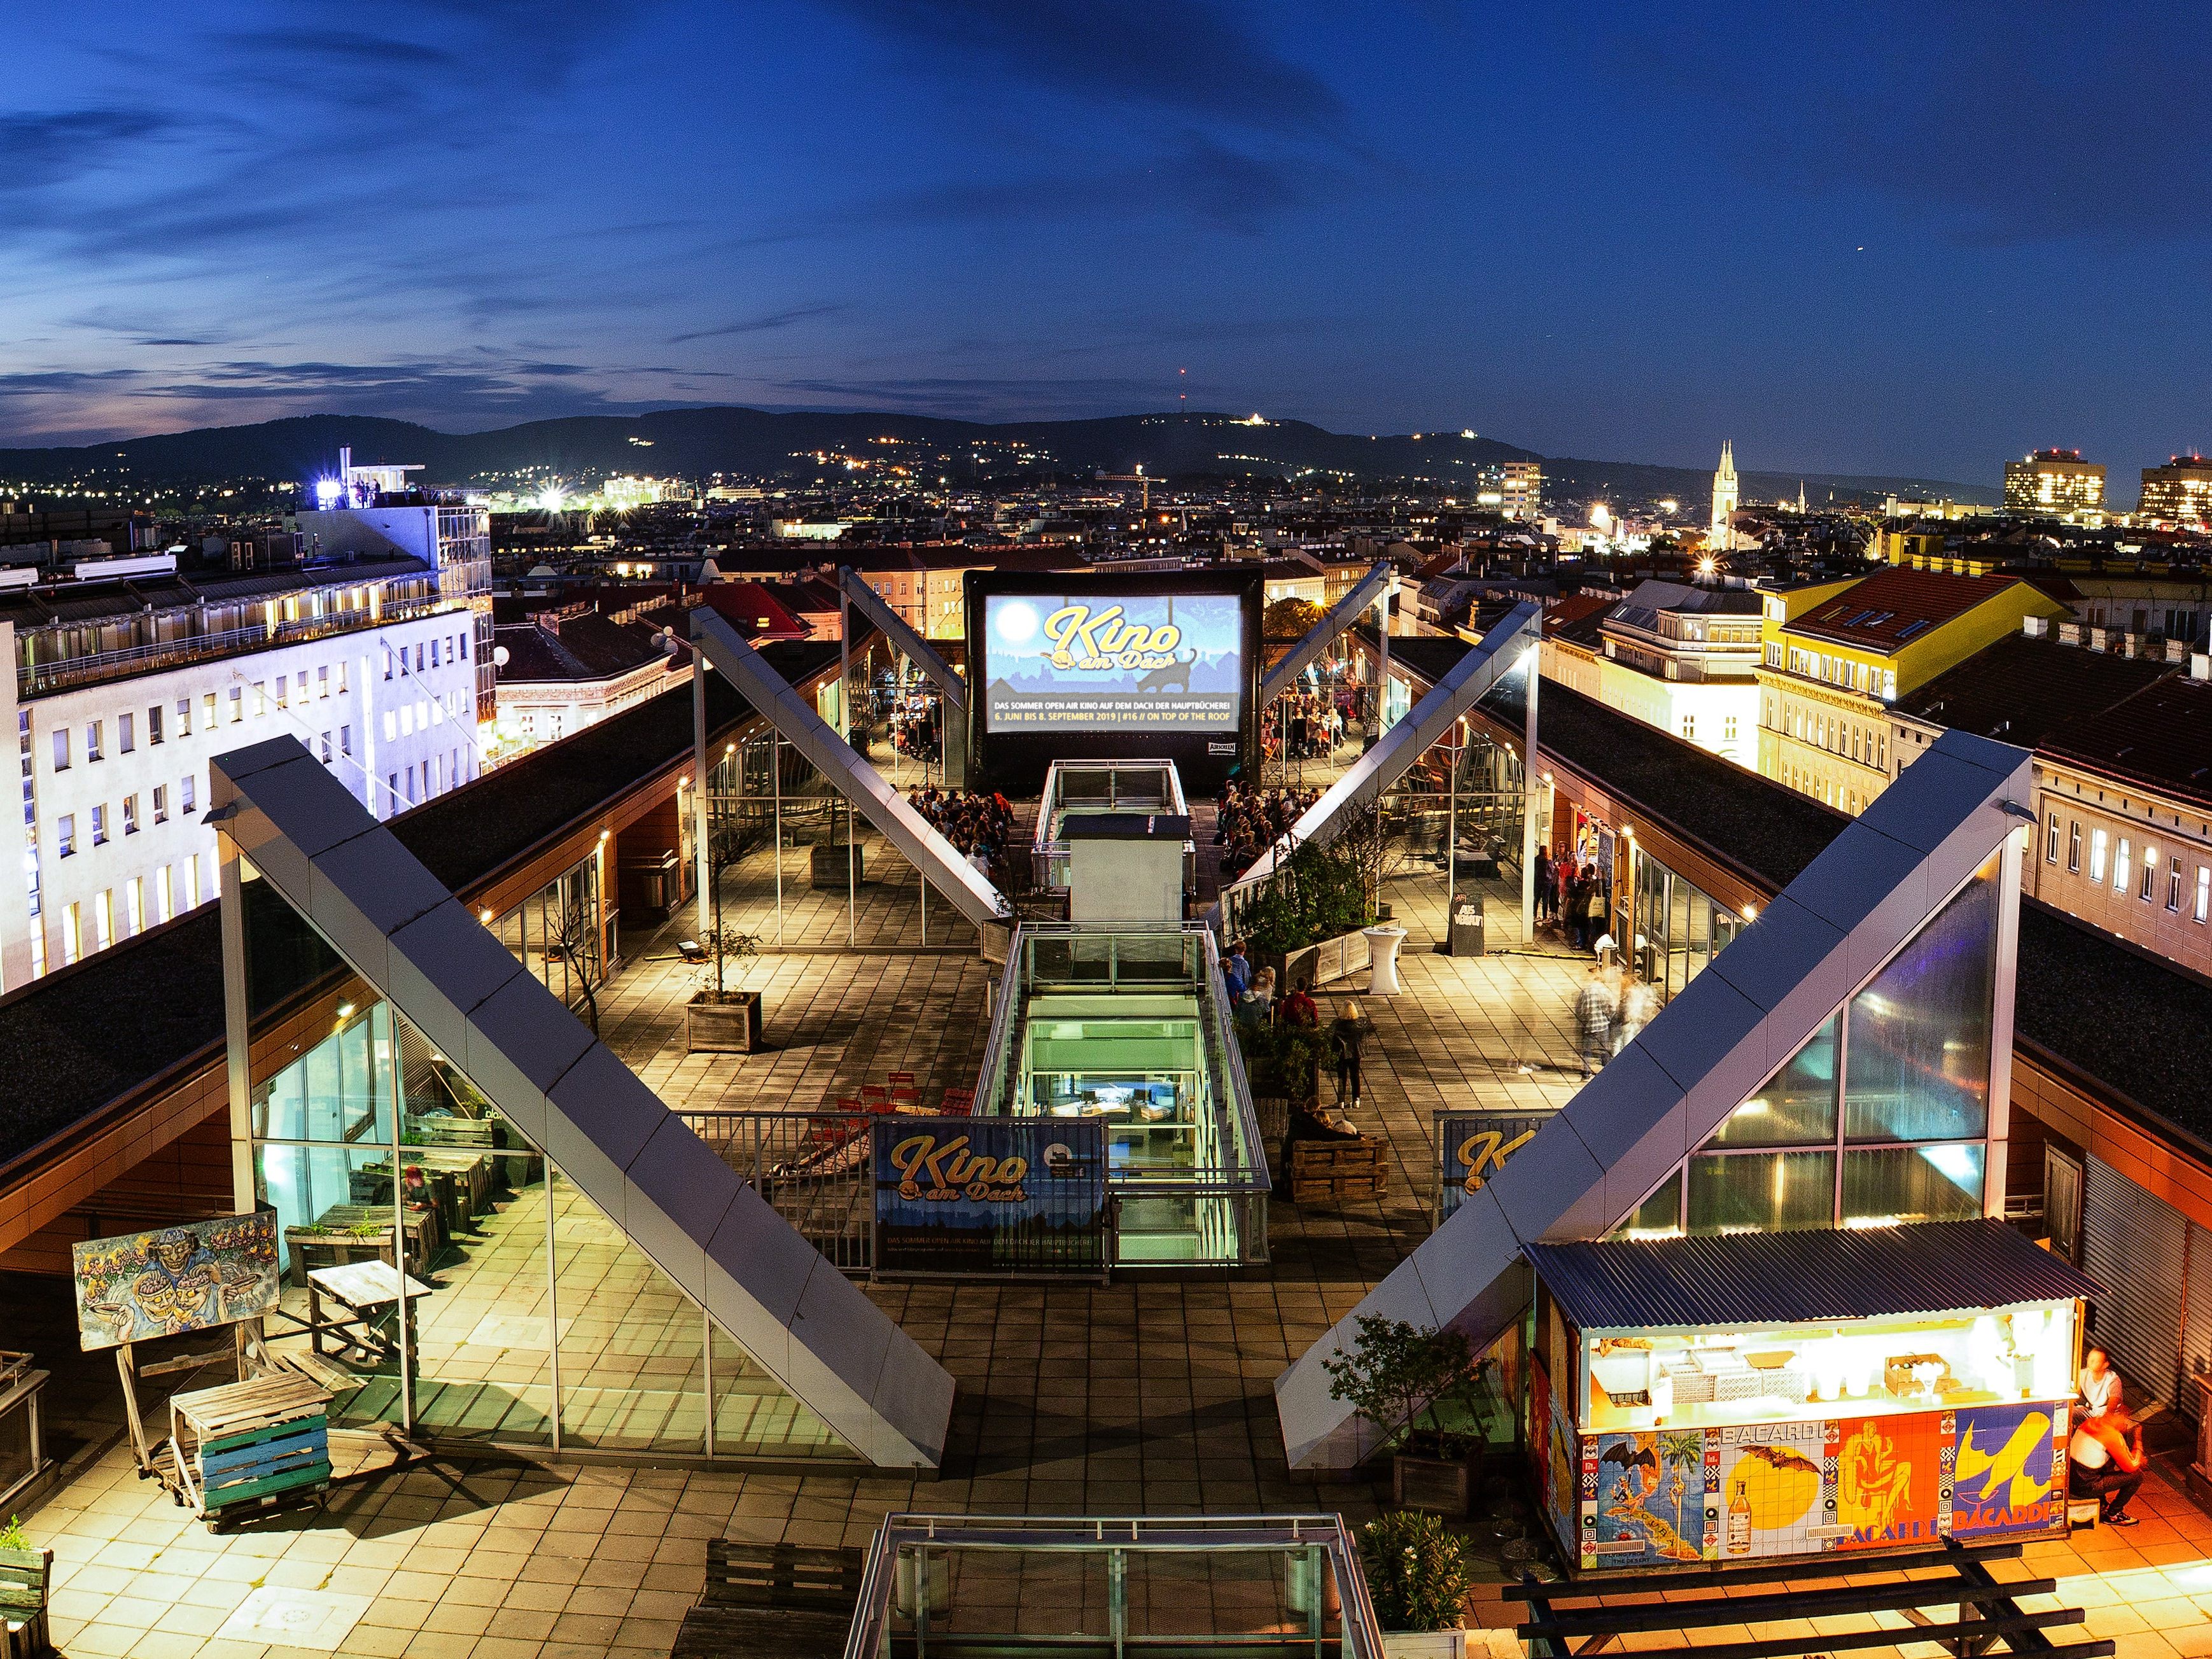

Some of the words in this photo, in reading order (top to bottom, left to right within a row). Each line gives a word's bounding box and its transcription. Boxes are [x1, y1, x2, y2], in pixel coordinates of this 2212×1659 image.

[1044, 605, 1181, 658] Kino
[1078, 656, 1113, 669] am
[1117, 650, 1177, 669] Dach
[1172, 701, 1230, 710] HAUPTBÜCHEREI
[995, 712, 1002, 721] 6.
[1004, 712, 1022, 721] JUNI
[1025, 712, 1037, 721] BIS
[1039, 712, 1046, 721] 8.
[1048, 712, 1094, 721] SEPTEMBER
[1096, 712, 1116, 721] 2019
[1122, 712, 1138, 721] #16
[1147, 712, 1159, 721] ON
[1161, 712, 1177, 721] TOP
[1178, 712, 1189, 721] OF
[1191, 712, 1206, 721] THE
[1208, 712, 1230, 721] ROOF
[1459, 904, 1476, 914] AUS
[891, 1135, 1028, 1188] Kino
[925, 1186, 960, 1201] am
[966, 1182, 1027, 1201] Dach
[1721, 1420, 1823, 1444] BACARDI
[1952, 1502, 2050, 1531] BACARDI
[1641, 1513, 1675, 1547] CUBA
